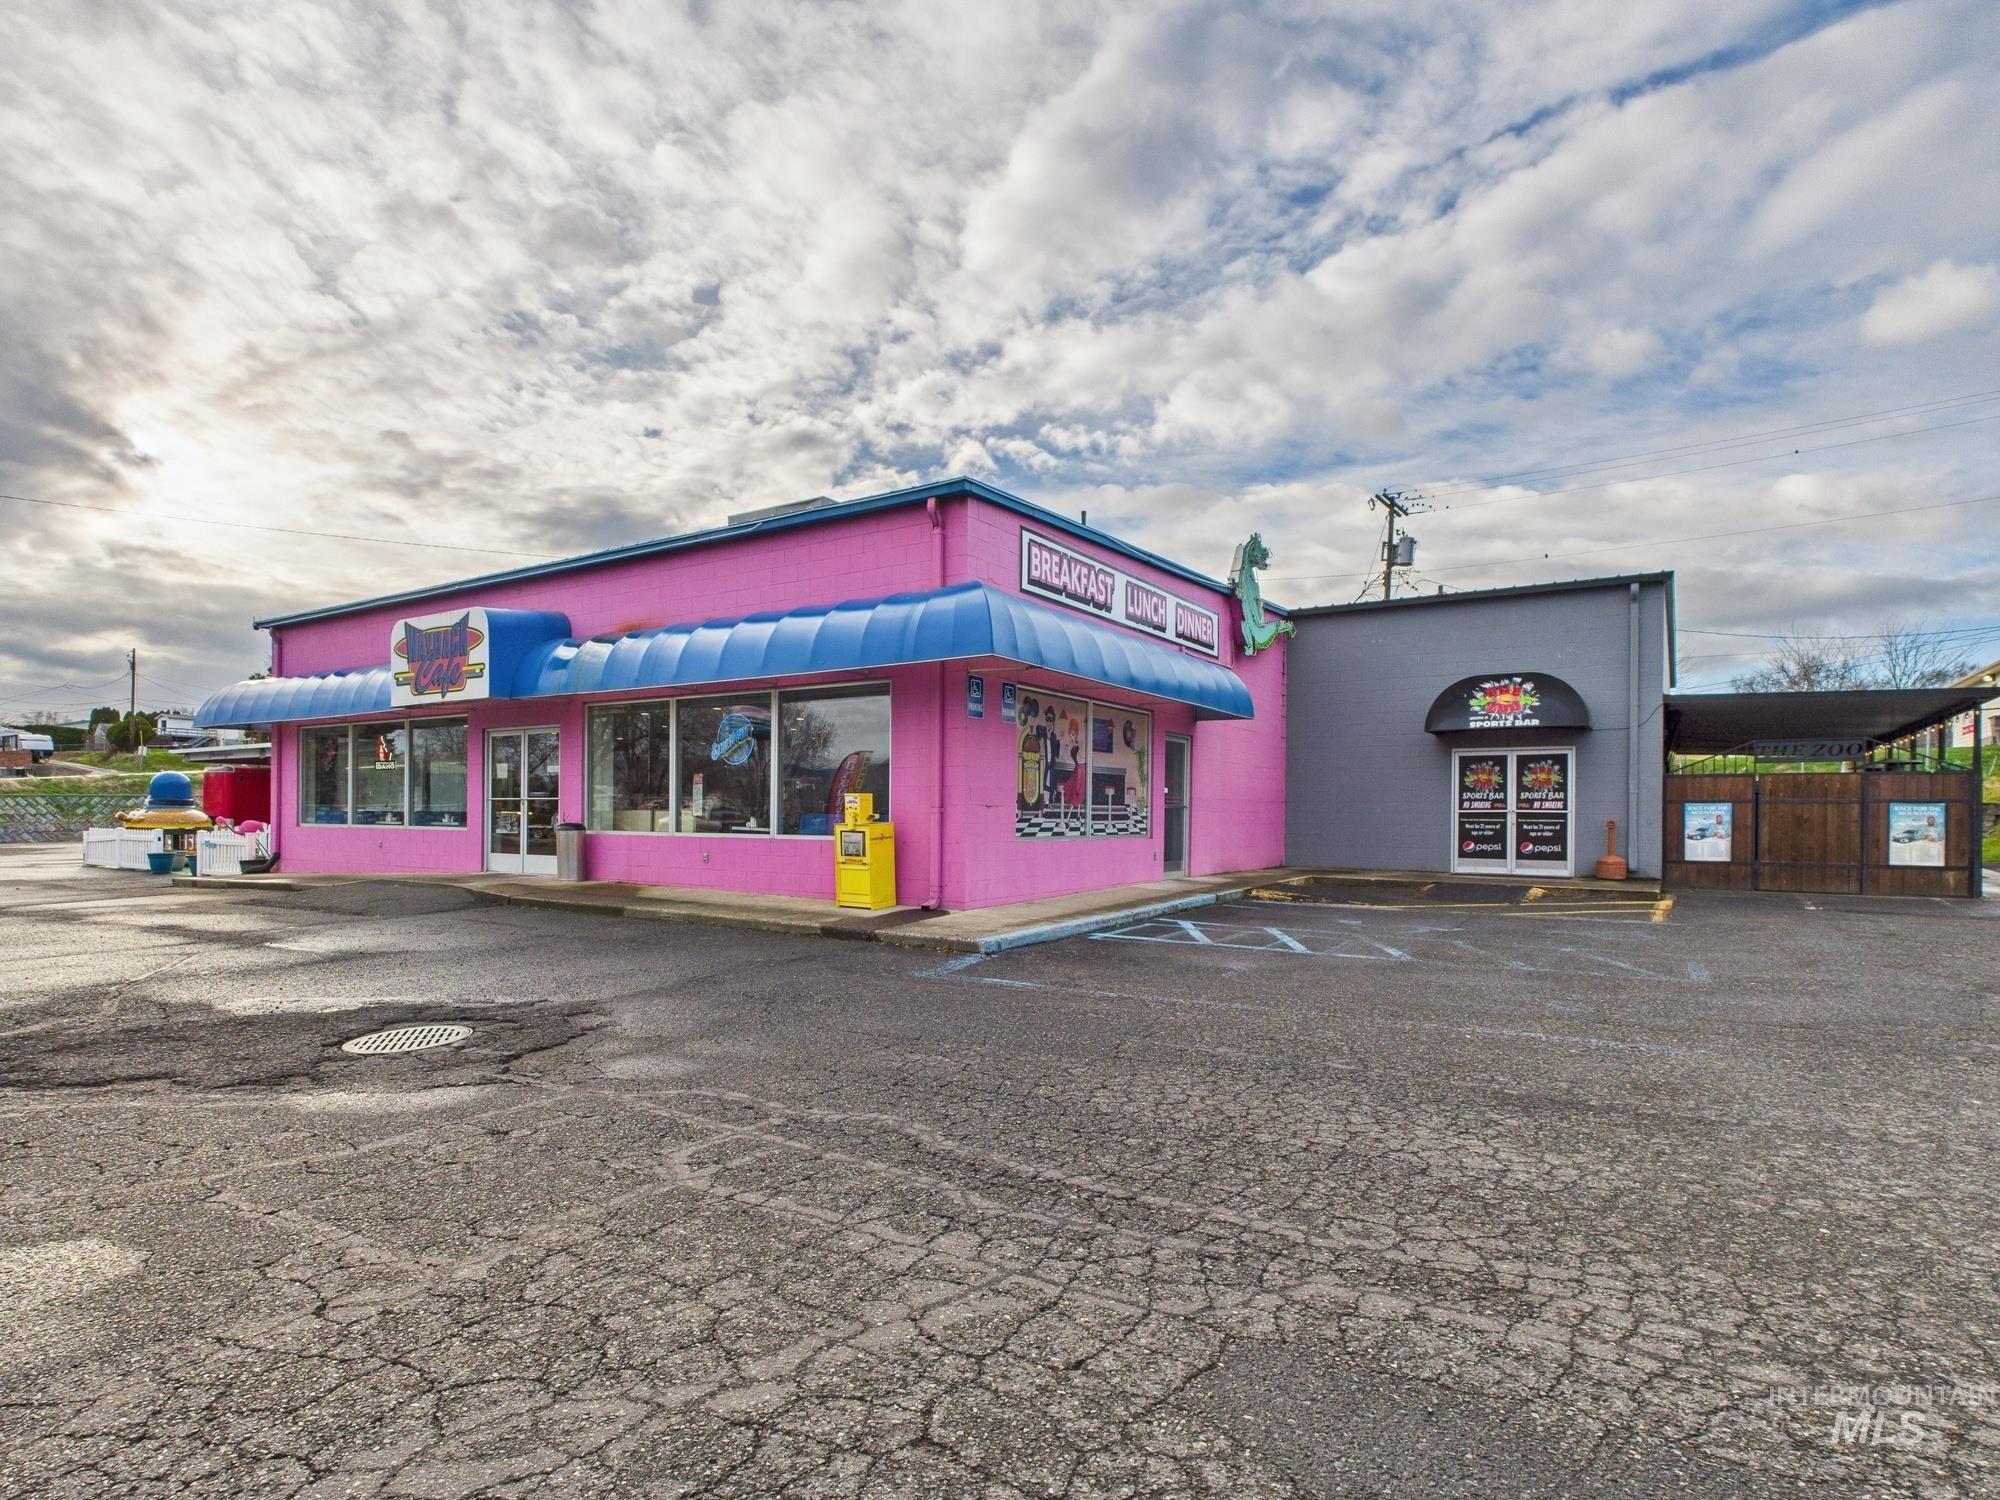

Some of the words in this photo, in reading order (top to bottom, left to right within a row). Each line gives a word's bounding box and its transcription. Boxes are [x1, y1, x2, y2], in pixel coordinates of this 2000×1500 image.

[1029, 542, 1114, 610] BREAKFAST
[1126, 583, 1167, 629] LUNCH
[1176, 605, 1214, 646] DINNER
[415, 652, 463, 699] Cafe
[1469, 719, 1512, 728] SPORTS
[1514, 718, 1540, 726] BAR
[1811, 743, 1863, 757] ZOO
[1462, 792, 1487, 800] SPORTS
[1488, 792, 1504, 800] BAR
[1520, 791, 1546, 800] SPORTS
[1547, 791, 1565, 800] BAR
[1463, 801, 1470, 809] NO
[1471, 801, 1492, 809] SMOKING
[1533, 801, 1541, 809] NO
[1541, 801, 1564, 809] SMOKING
[1476, 843, 1502, 852] pepsi
[1535, 844, 1562, 853] pepsi
